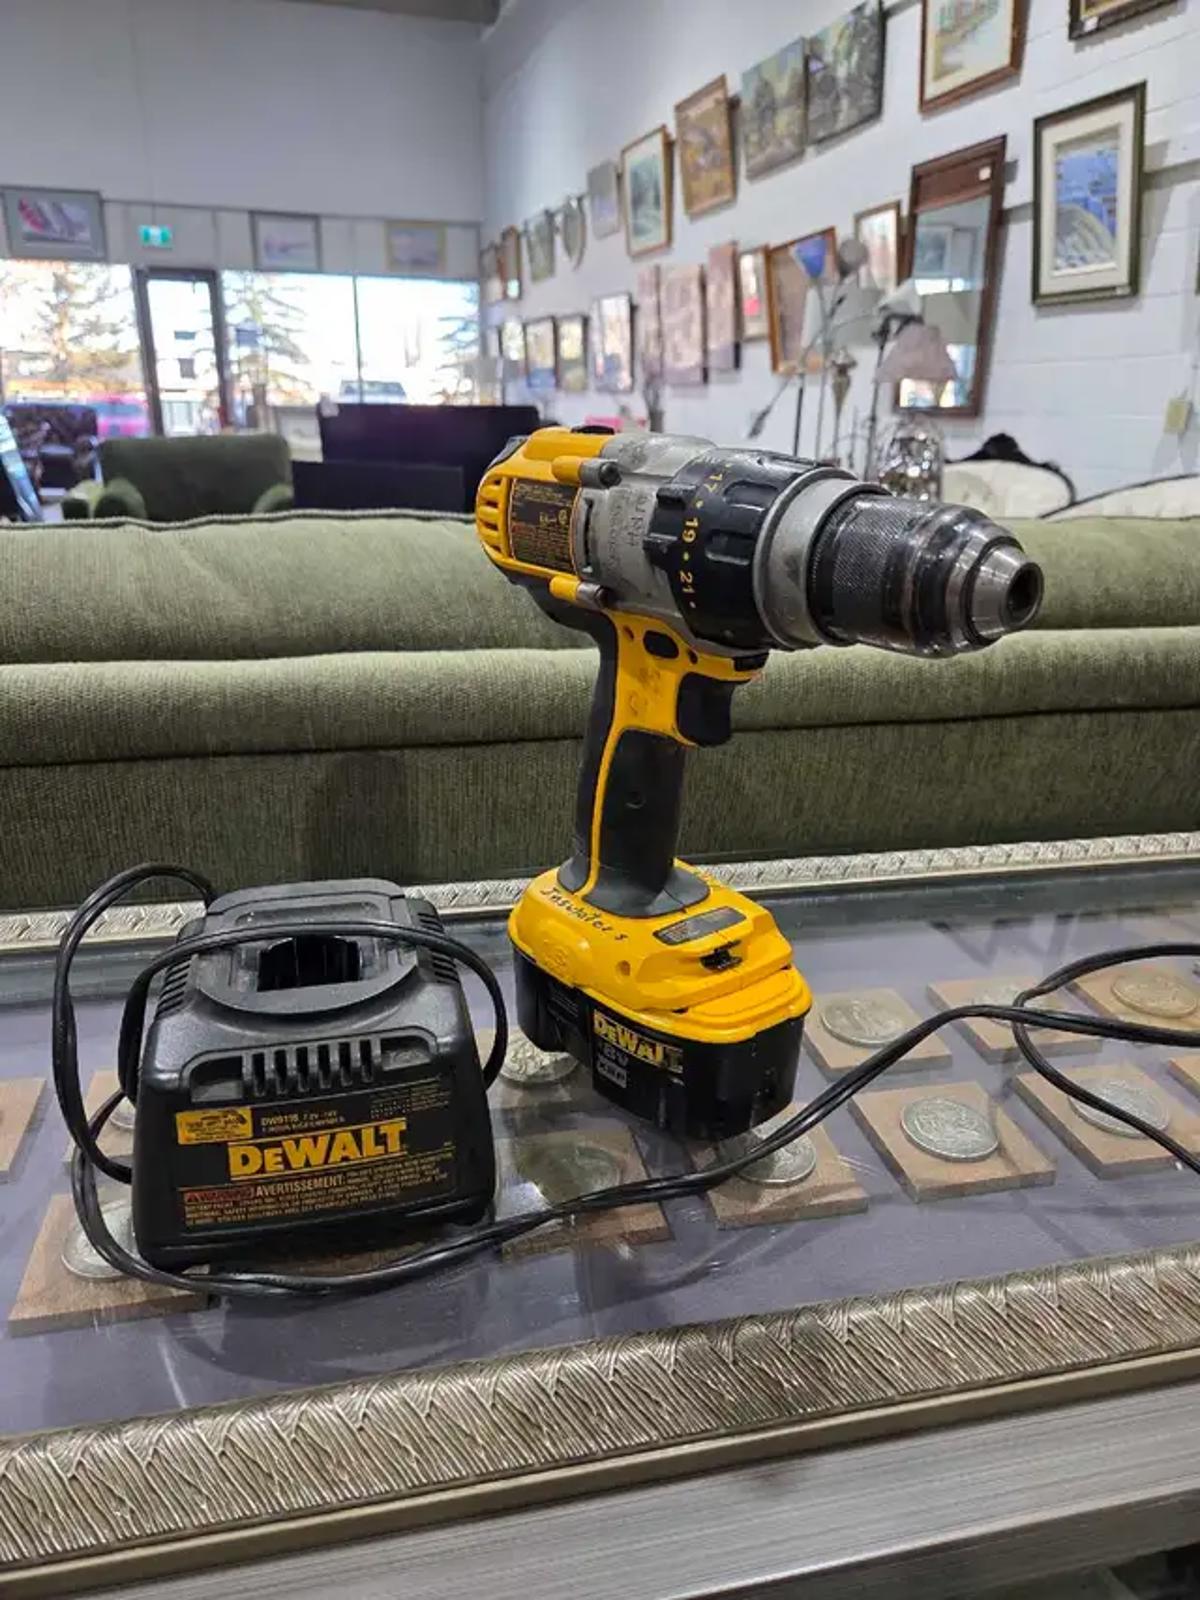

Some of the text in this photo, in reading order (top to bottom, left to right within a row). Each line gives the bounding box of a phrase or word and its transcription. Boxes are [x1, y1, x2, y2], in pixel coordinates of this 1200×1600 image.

[704, 473, 723, 492] 17
[682, 517, 699, 544] 19
[680, 571, 696, 594] 21
